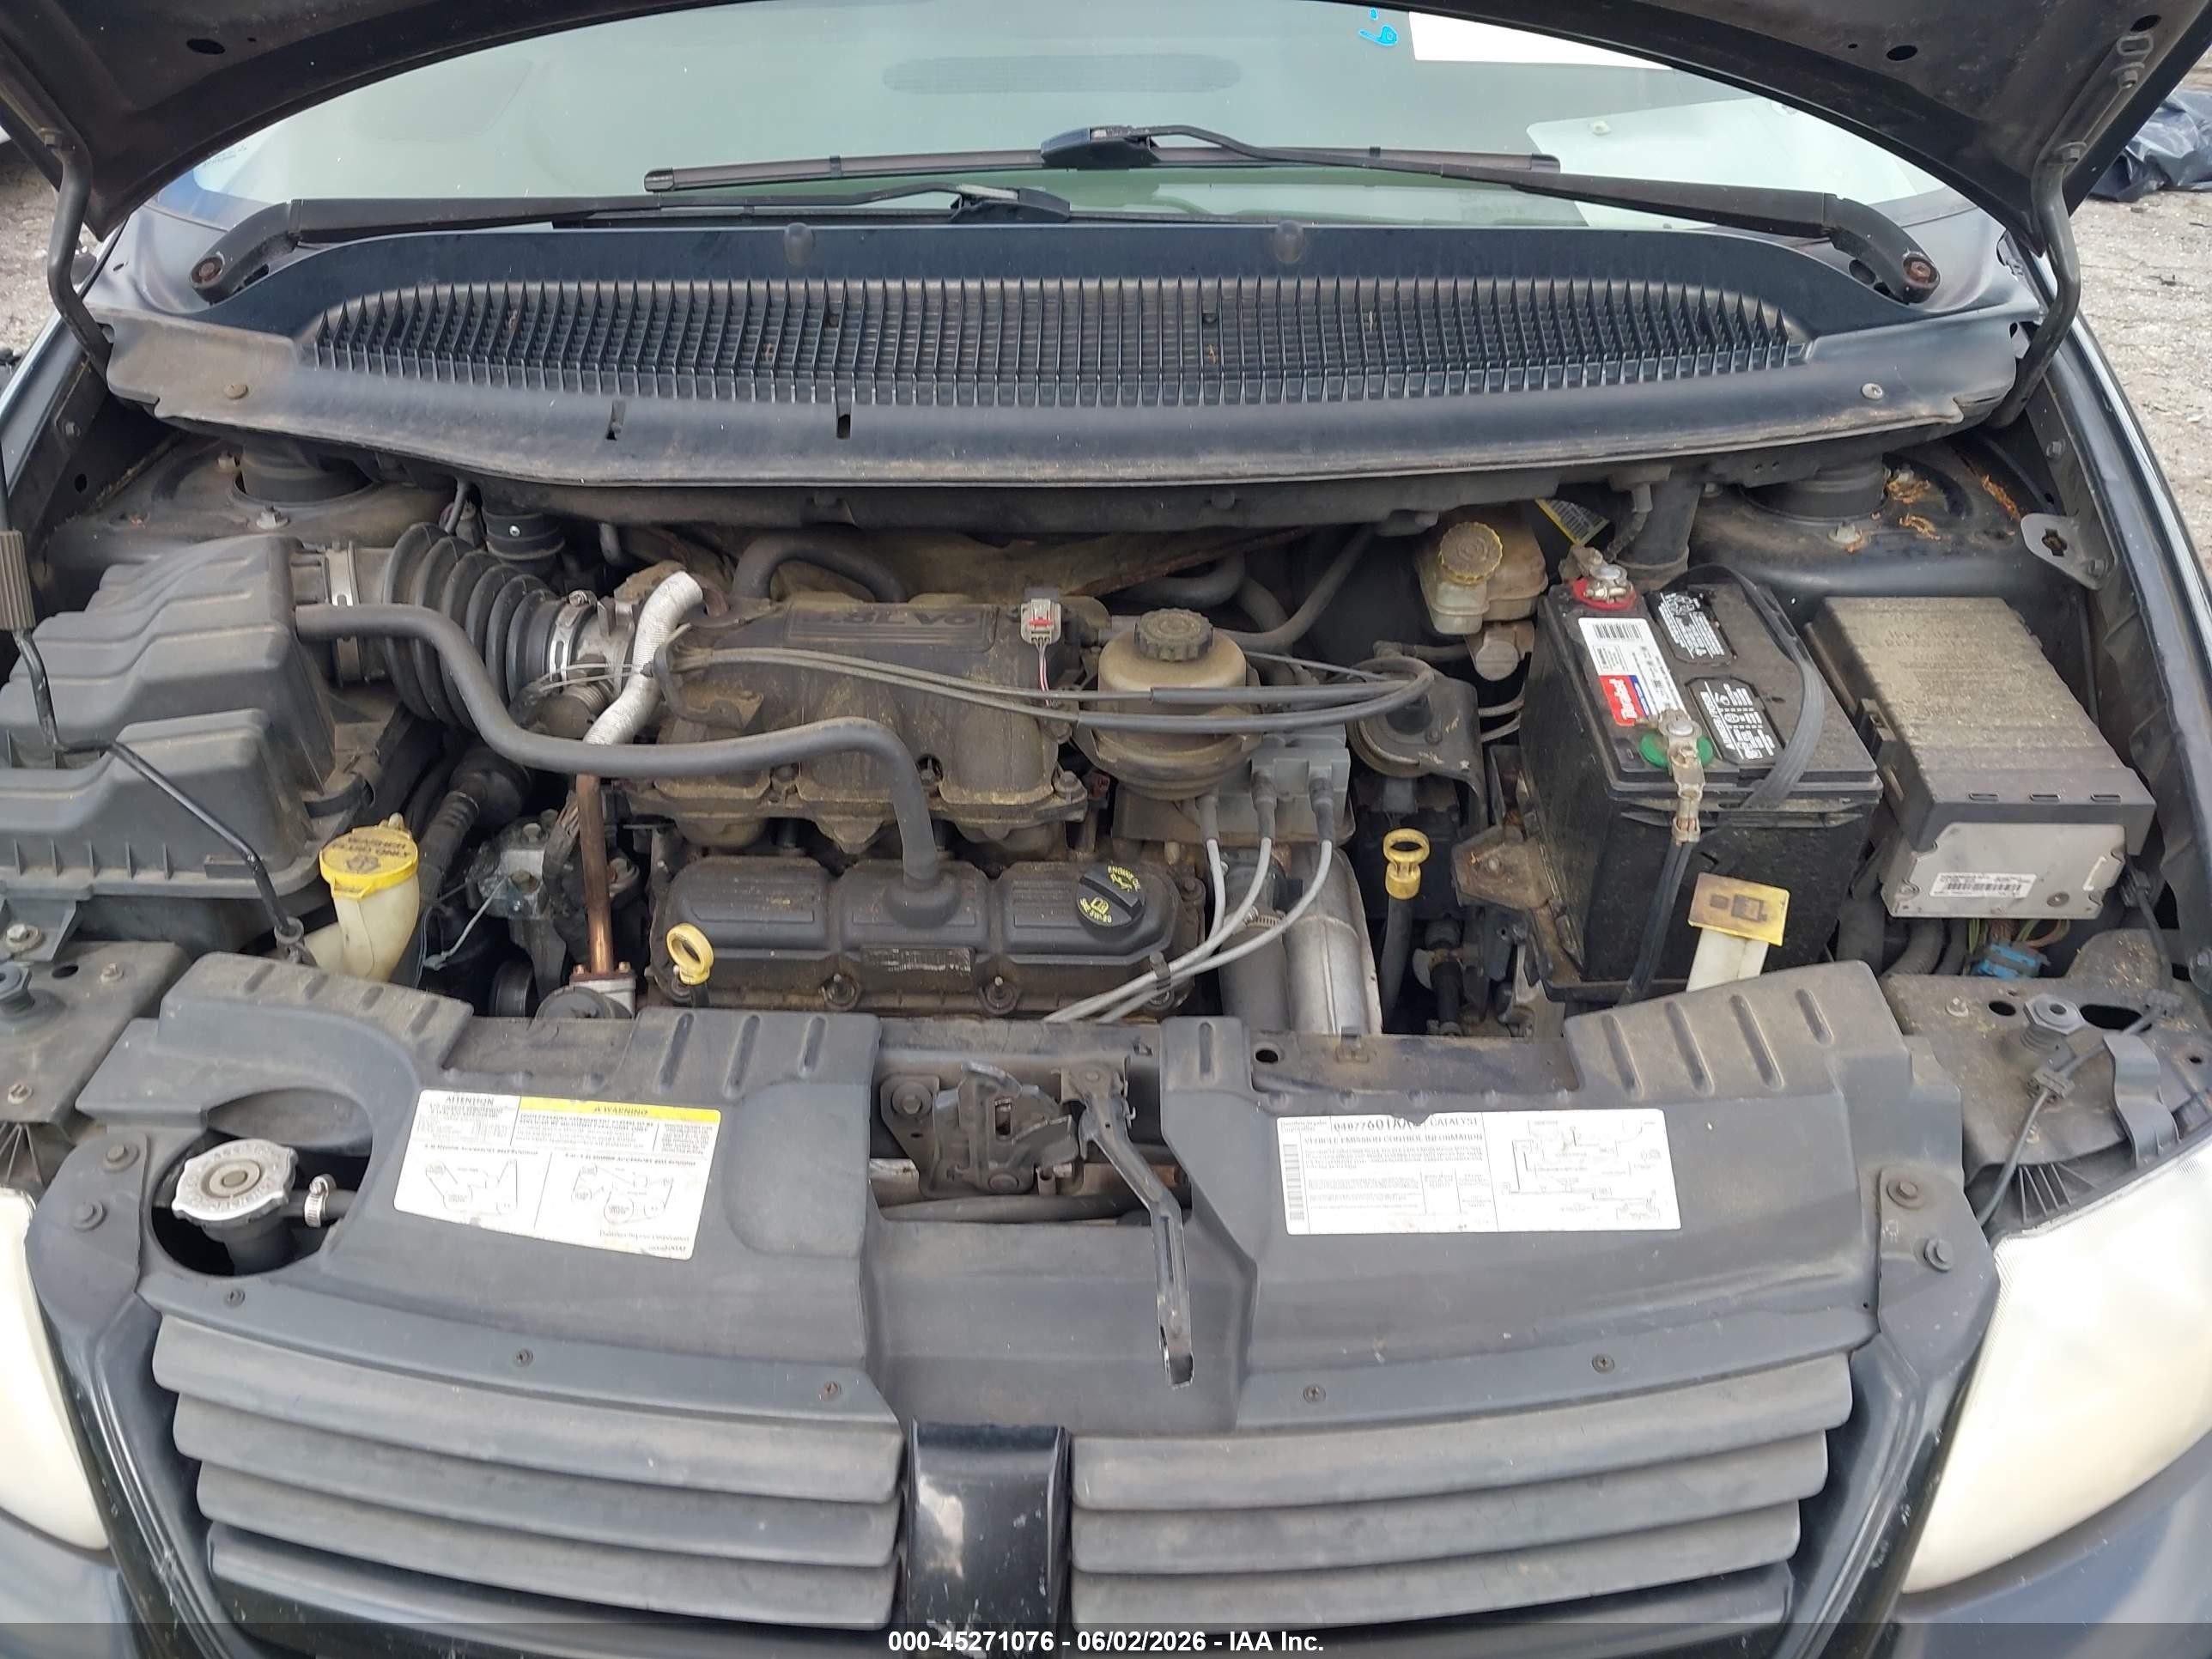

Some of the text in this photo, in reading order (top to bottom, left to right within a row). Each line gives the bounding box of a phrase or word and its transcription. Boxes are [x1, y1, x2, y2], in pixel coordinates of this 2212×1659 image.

[1107, 865, 1134, 881] ENGINE
[446, 1097, 495, 1107] ATTENTION
[603, 1104, 649, 1116] WARNING
[1429, 1116, 1478, 1127] CATALYST
[1304, 1133, 1484, 1145] VEHICLE EMISSION CONTROL INFORMATION
